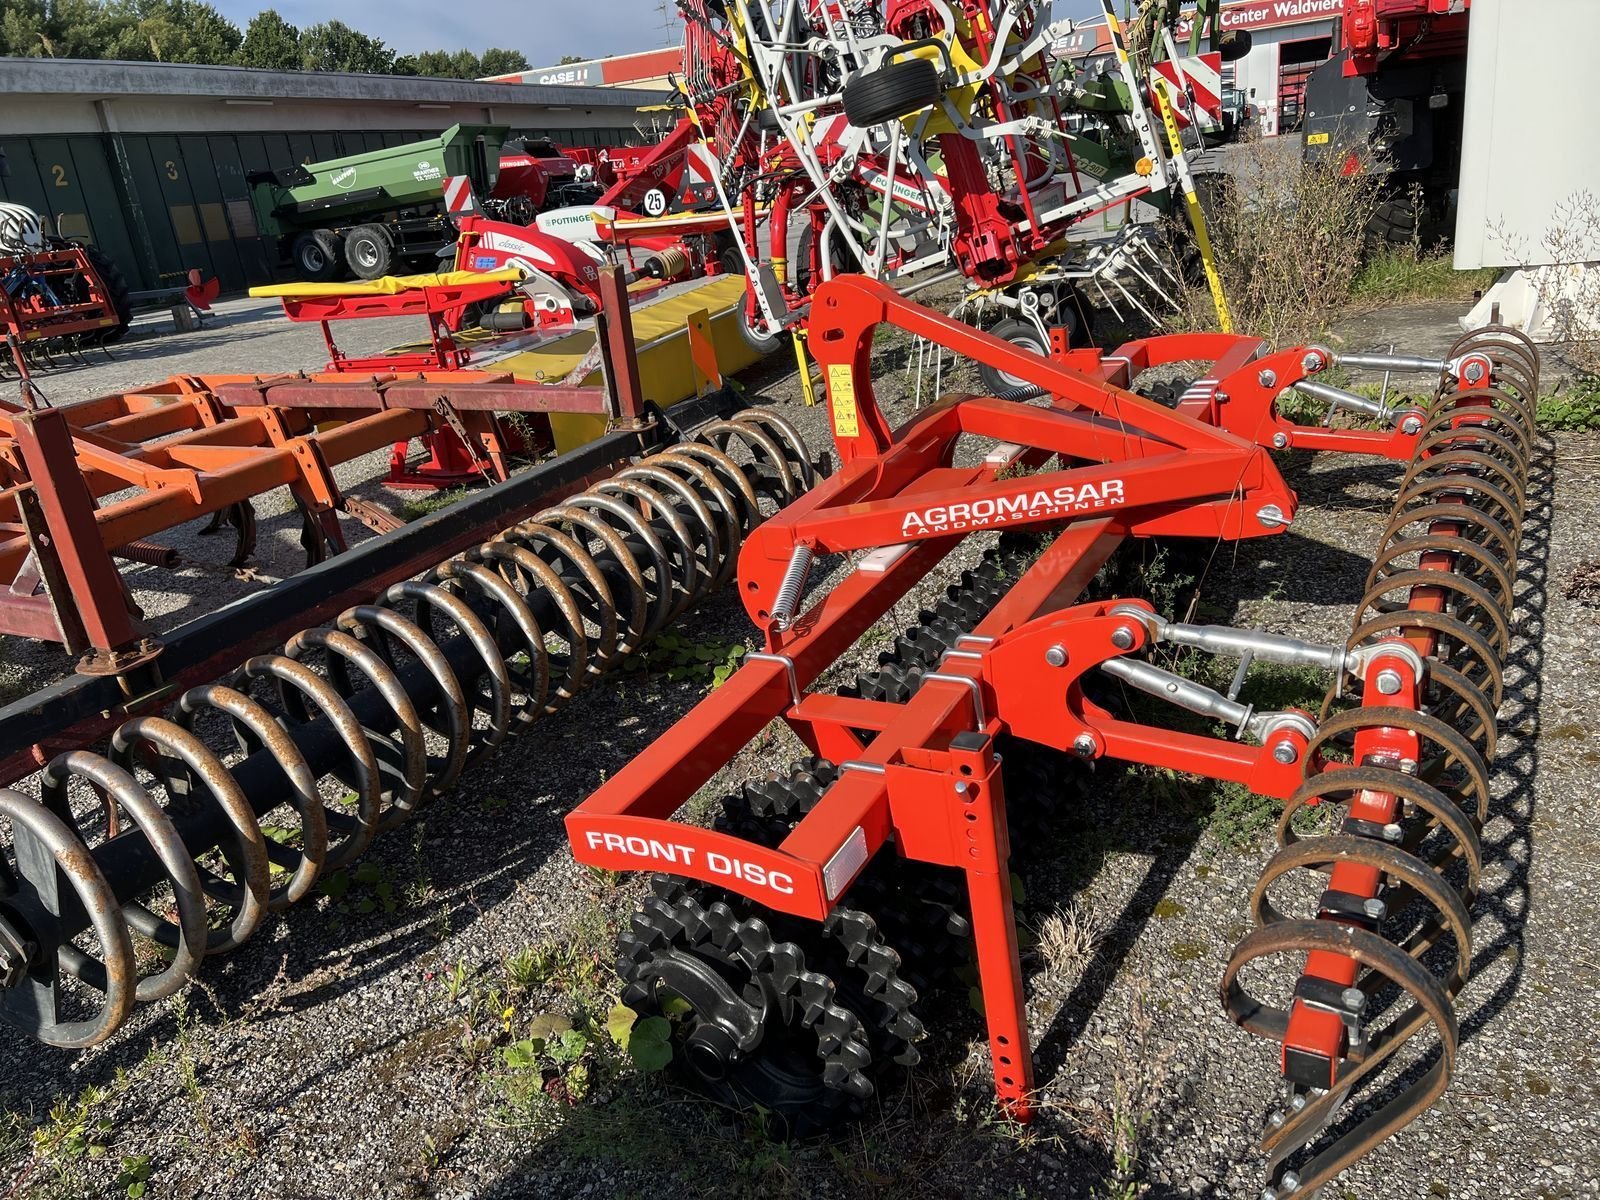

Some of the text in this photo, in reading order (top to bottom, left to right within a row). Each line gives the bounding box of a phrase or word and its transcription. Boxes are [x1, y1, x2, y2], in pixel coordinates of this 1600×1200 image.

[1220, 8, 1270, 26] Center
[1274, 0, 1344, 18] Waldviert
[539, 71, 575, 85] CASE
[51, 164, 69, 186] 2
[165, 160, 179, 181] 3
[647, 193, 661, 211] 25
[498, 239, 525, 251] classic
[901, 479, 1125, 530] AGROMASAR
[902, 496, 1125, 537] LANDMASCHINEN
[585, 831, 794, 895] FRONT DISC
